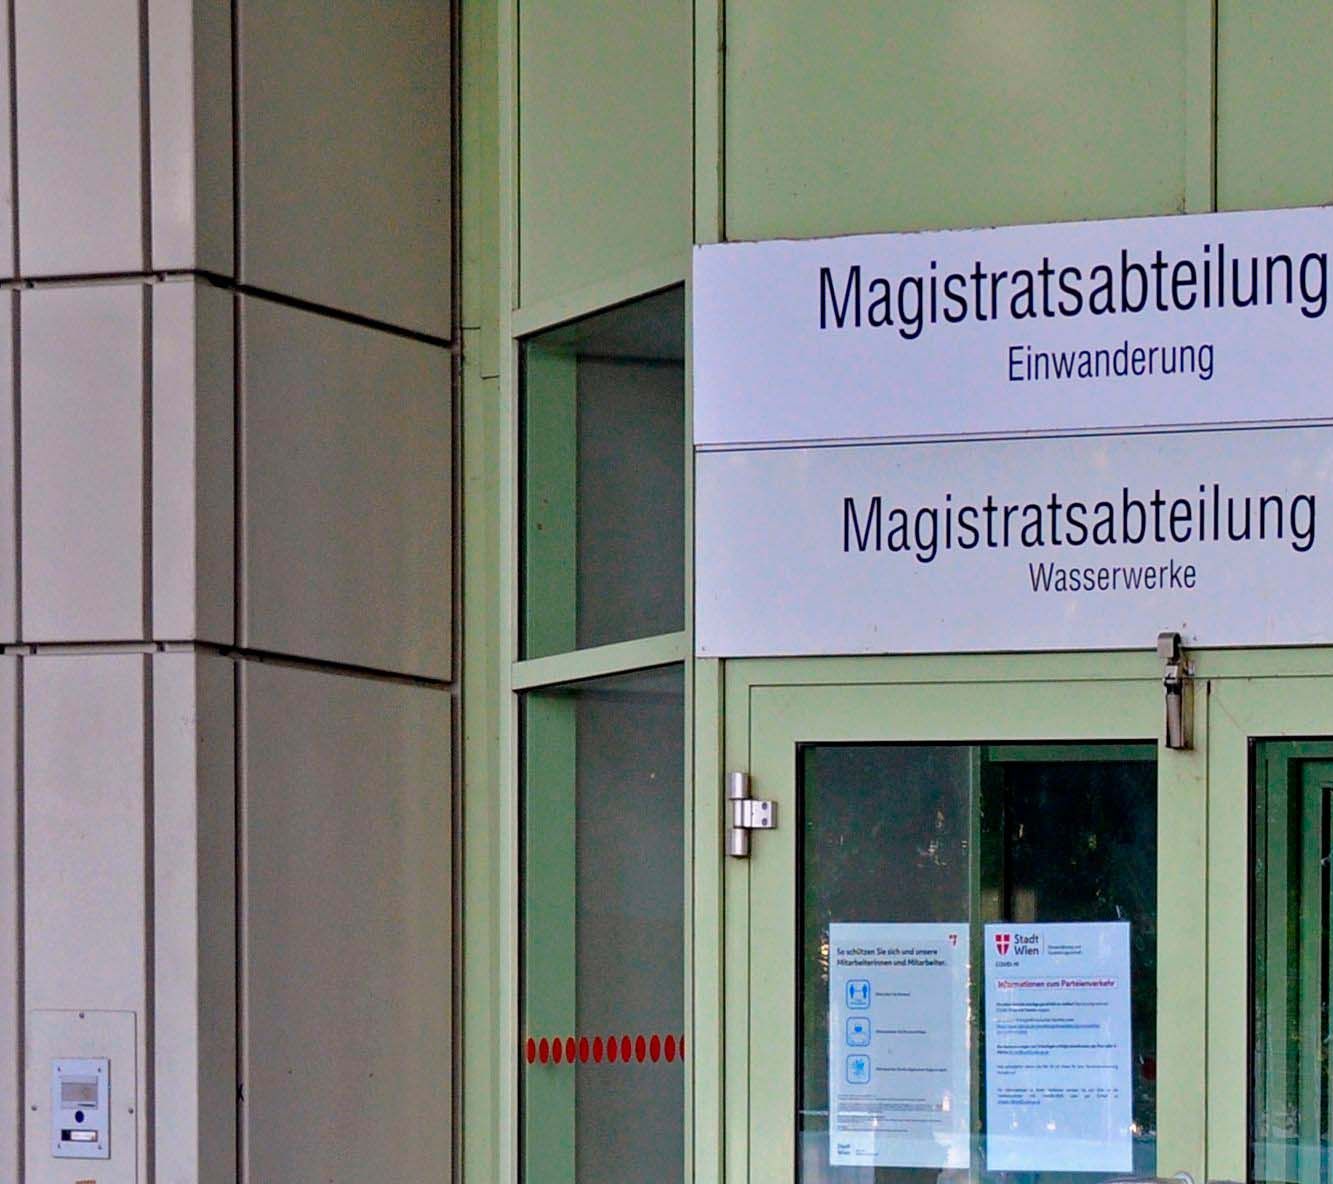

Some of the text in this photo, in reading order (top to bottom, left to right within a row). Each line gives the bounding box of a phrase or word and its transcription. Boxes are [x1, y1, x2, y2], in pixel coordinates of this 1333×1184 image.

[817, 242, 1328, 340] Magistratsabteilung
[1008, 340, 1214, 382] Einwanderung
[843, 483, 1316, 564] Magistratsabteilung
[1029, 560, 1196, 592] Wasserwerke
[1013, 934, 1040, 944] Stadt
[1013, 945, 1040, 956] Wien
